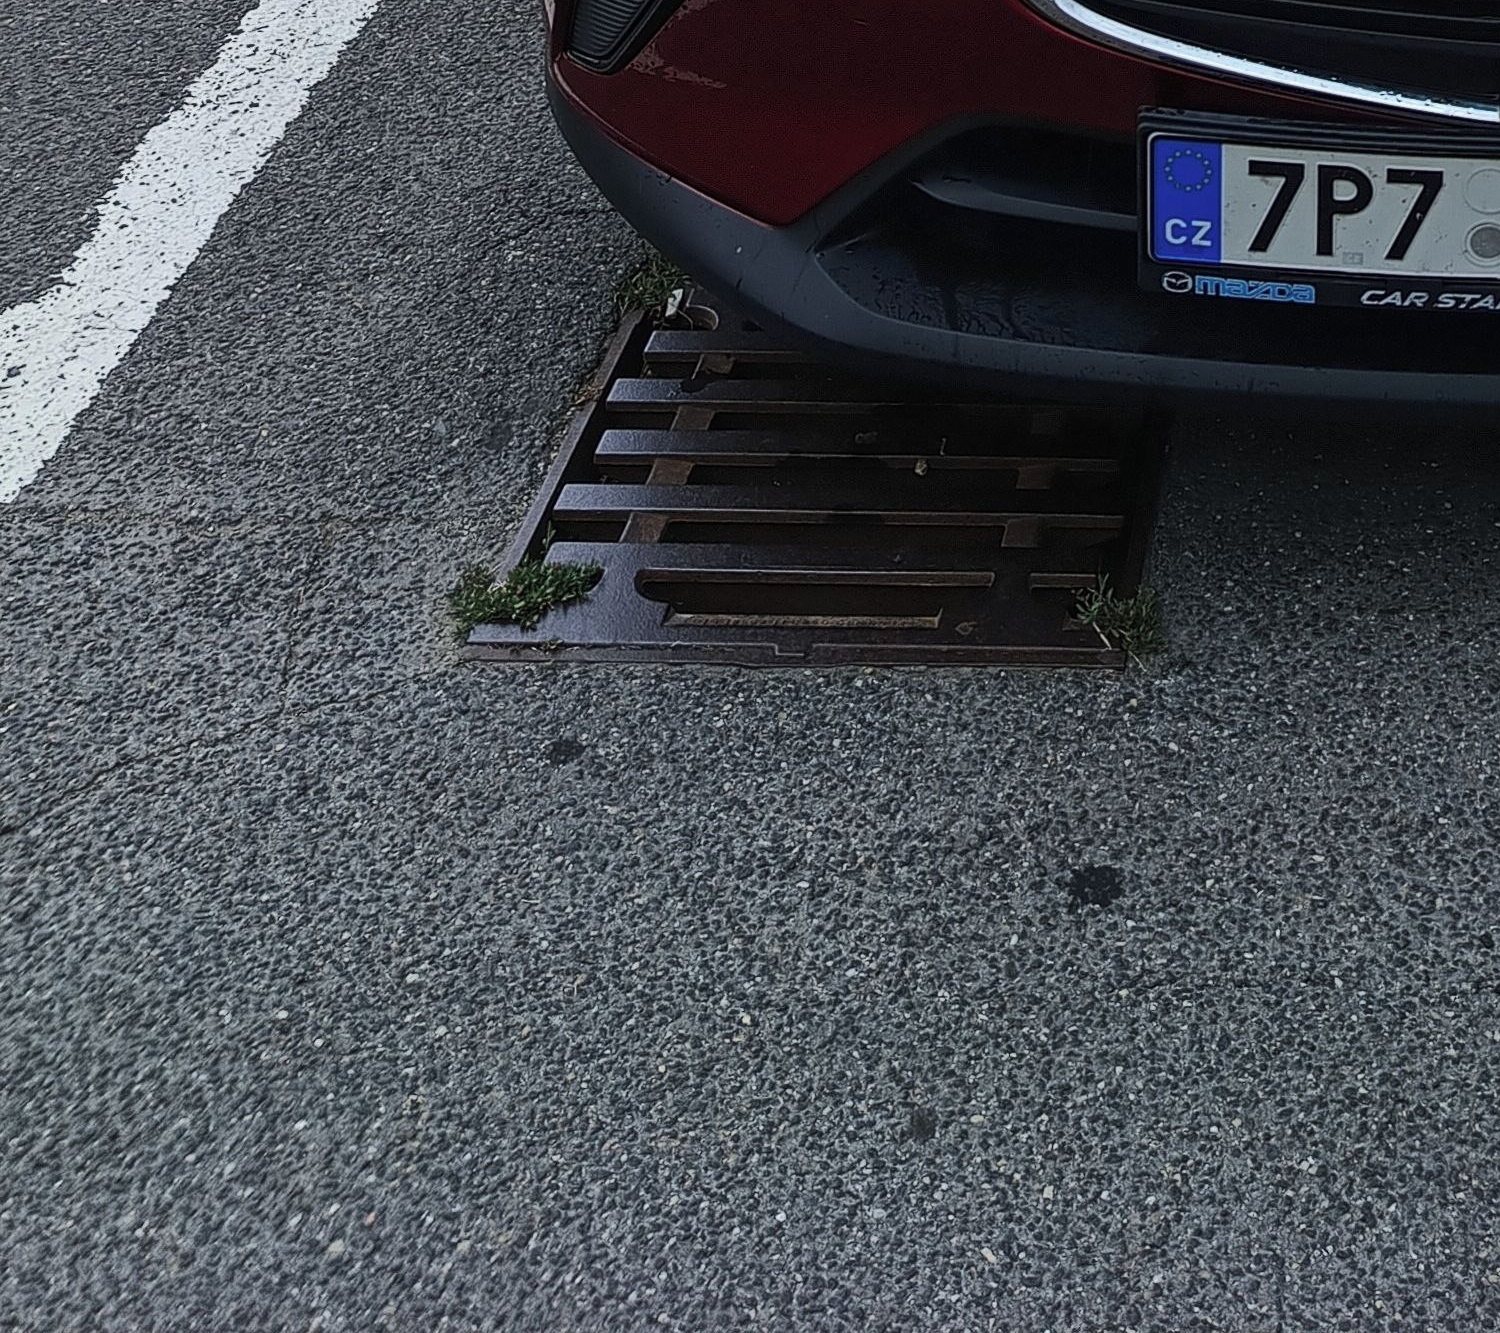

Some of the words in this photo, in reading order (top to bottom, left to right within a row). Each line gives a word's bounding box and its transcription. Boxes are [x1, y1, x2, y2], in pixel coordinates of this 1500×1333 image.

[1248, 159, 1444, 261] 7P7
[1165, 219, 1212, 246] CZ
[1361, 289, 1428, 307] CAR
